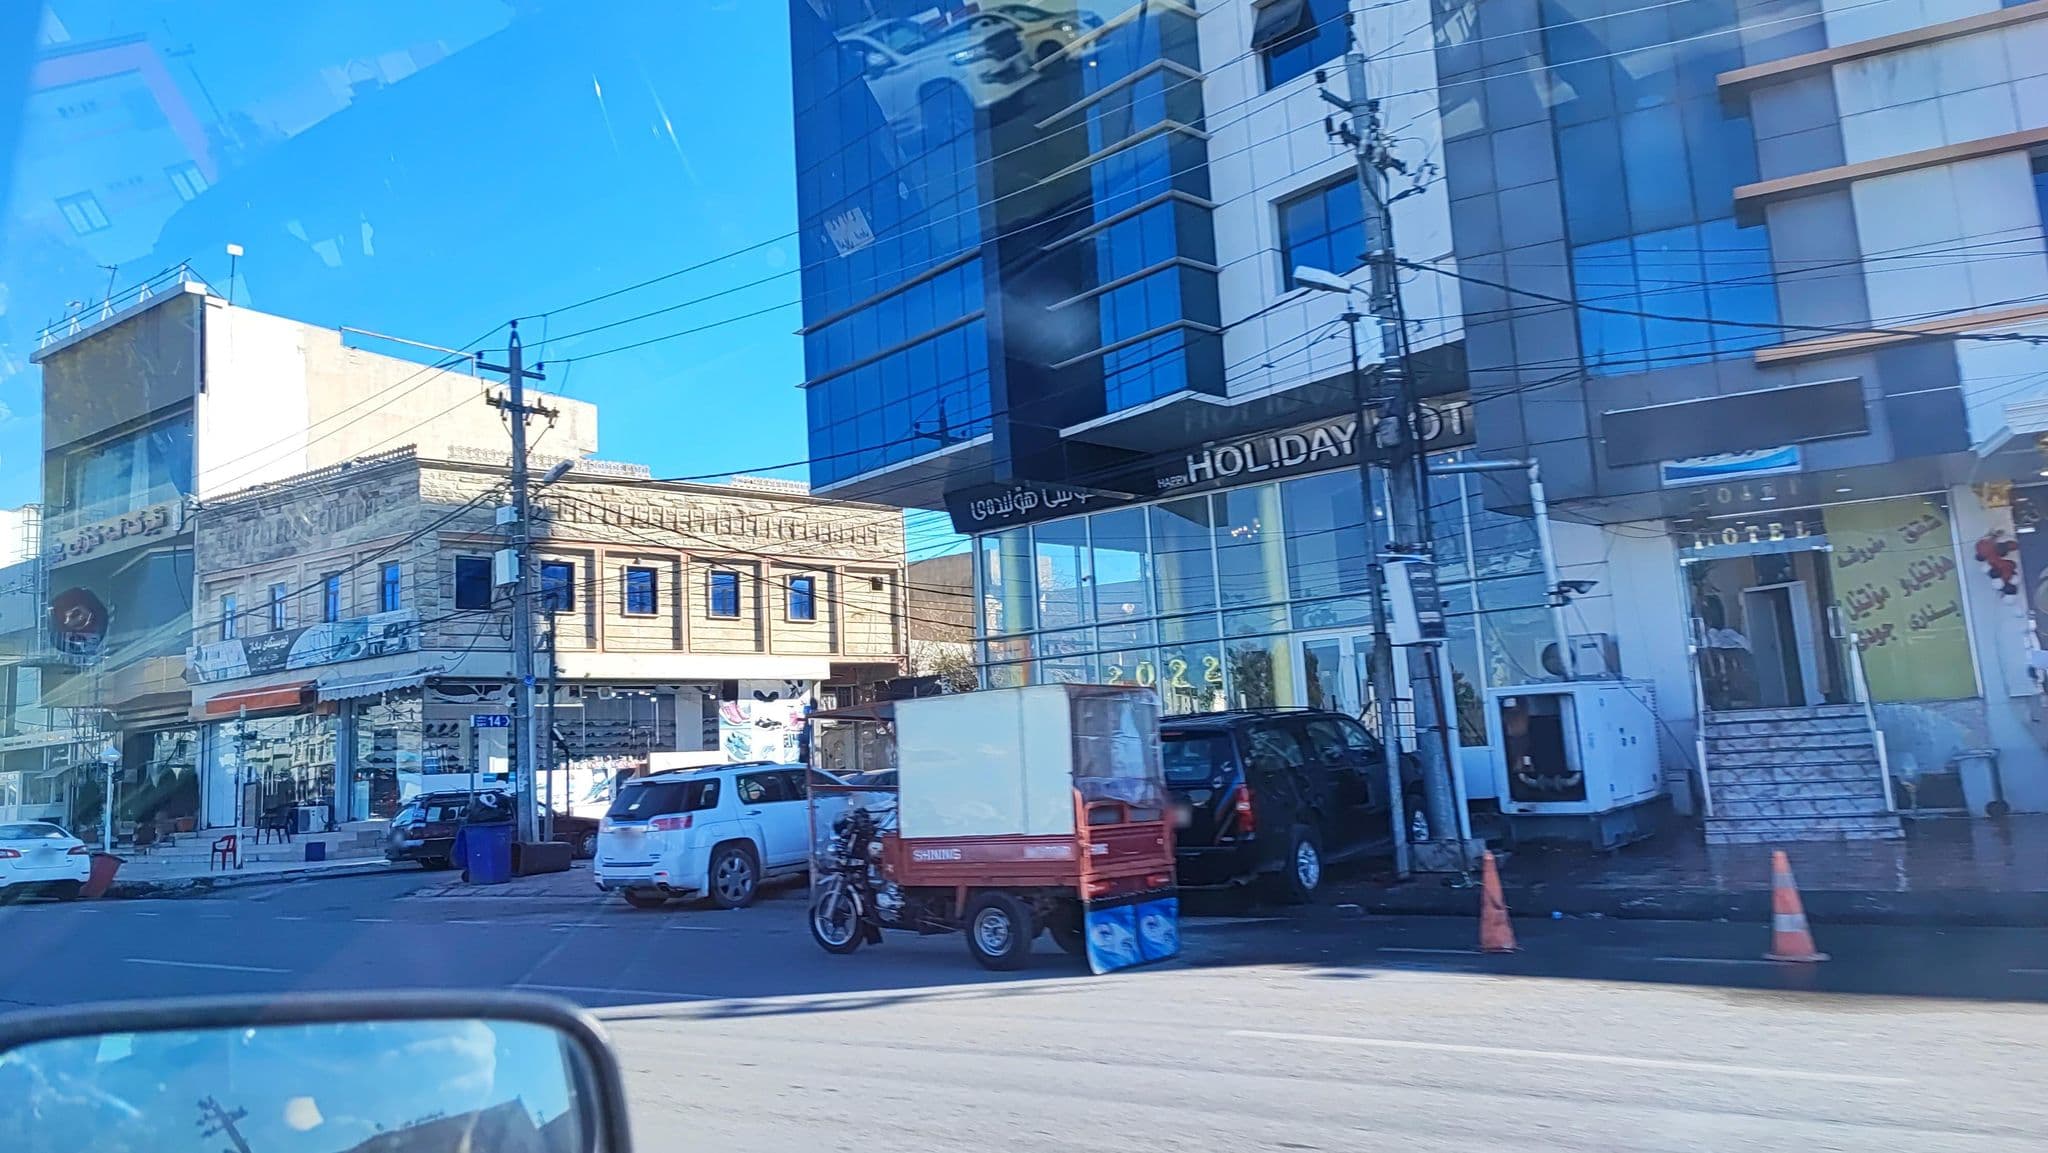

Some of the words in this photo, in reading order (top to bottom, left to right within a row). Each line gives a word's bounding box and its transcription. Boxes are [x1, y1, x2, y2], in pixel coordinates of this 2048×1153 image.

[1186, 422, 1357, 483] HOLIDAY
[1108, 655, 1222, 688] 2022
[488, 715, 501, 727] 14
